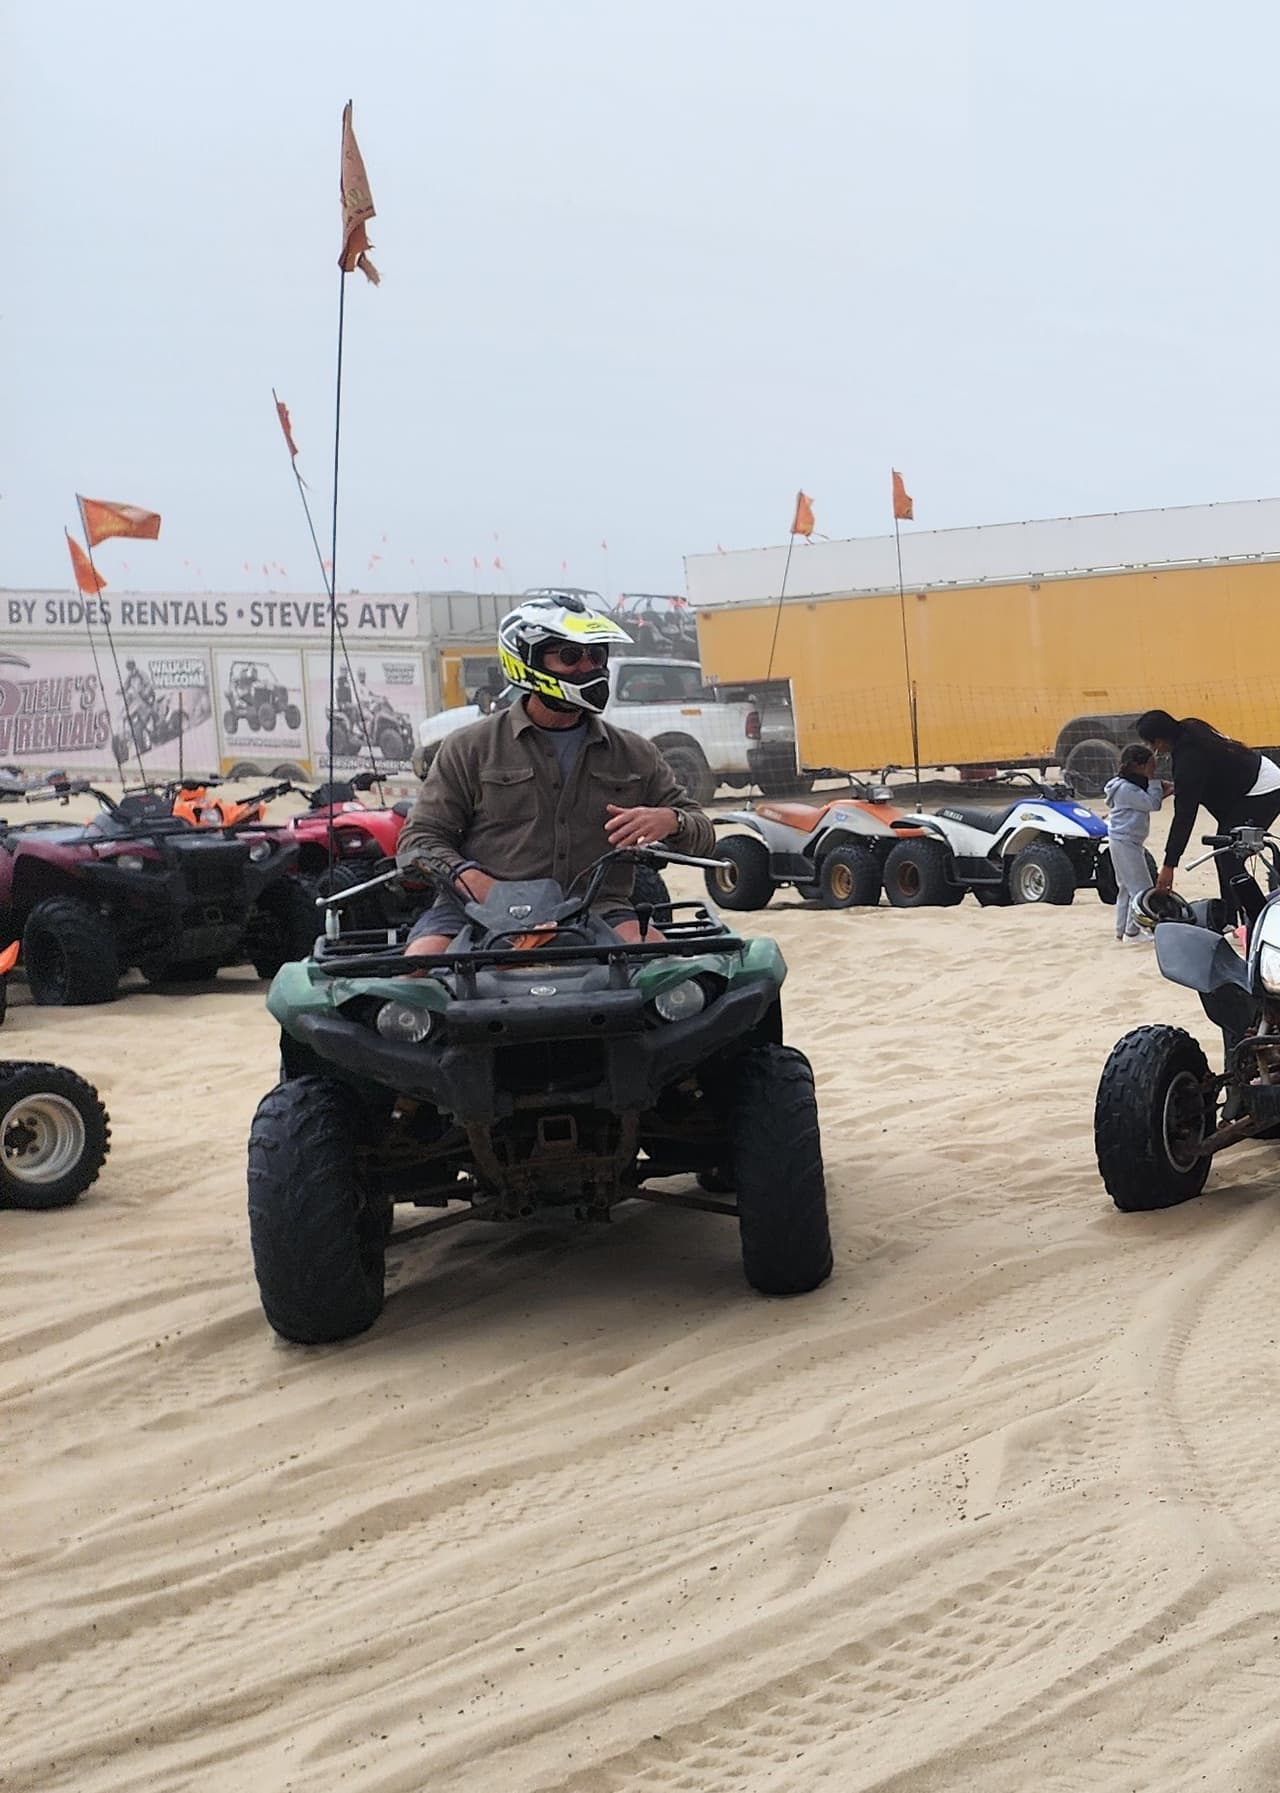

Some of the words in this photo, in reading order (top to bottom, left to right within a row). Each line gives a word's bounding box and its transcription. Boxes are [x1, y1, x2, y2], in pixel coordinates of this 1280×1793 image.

[8, 600, 36, 625] BY
[45, 599, 112, 625] SIDES
[121, 601, 228, 627] RENTALS
[250, 601, 349, 628] STEVE'S
[357, 603, 410, 629] ATV
[14, 710, 111, 753] RENTALS
